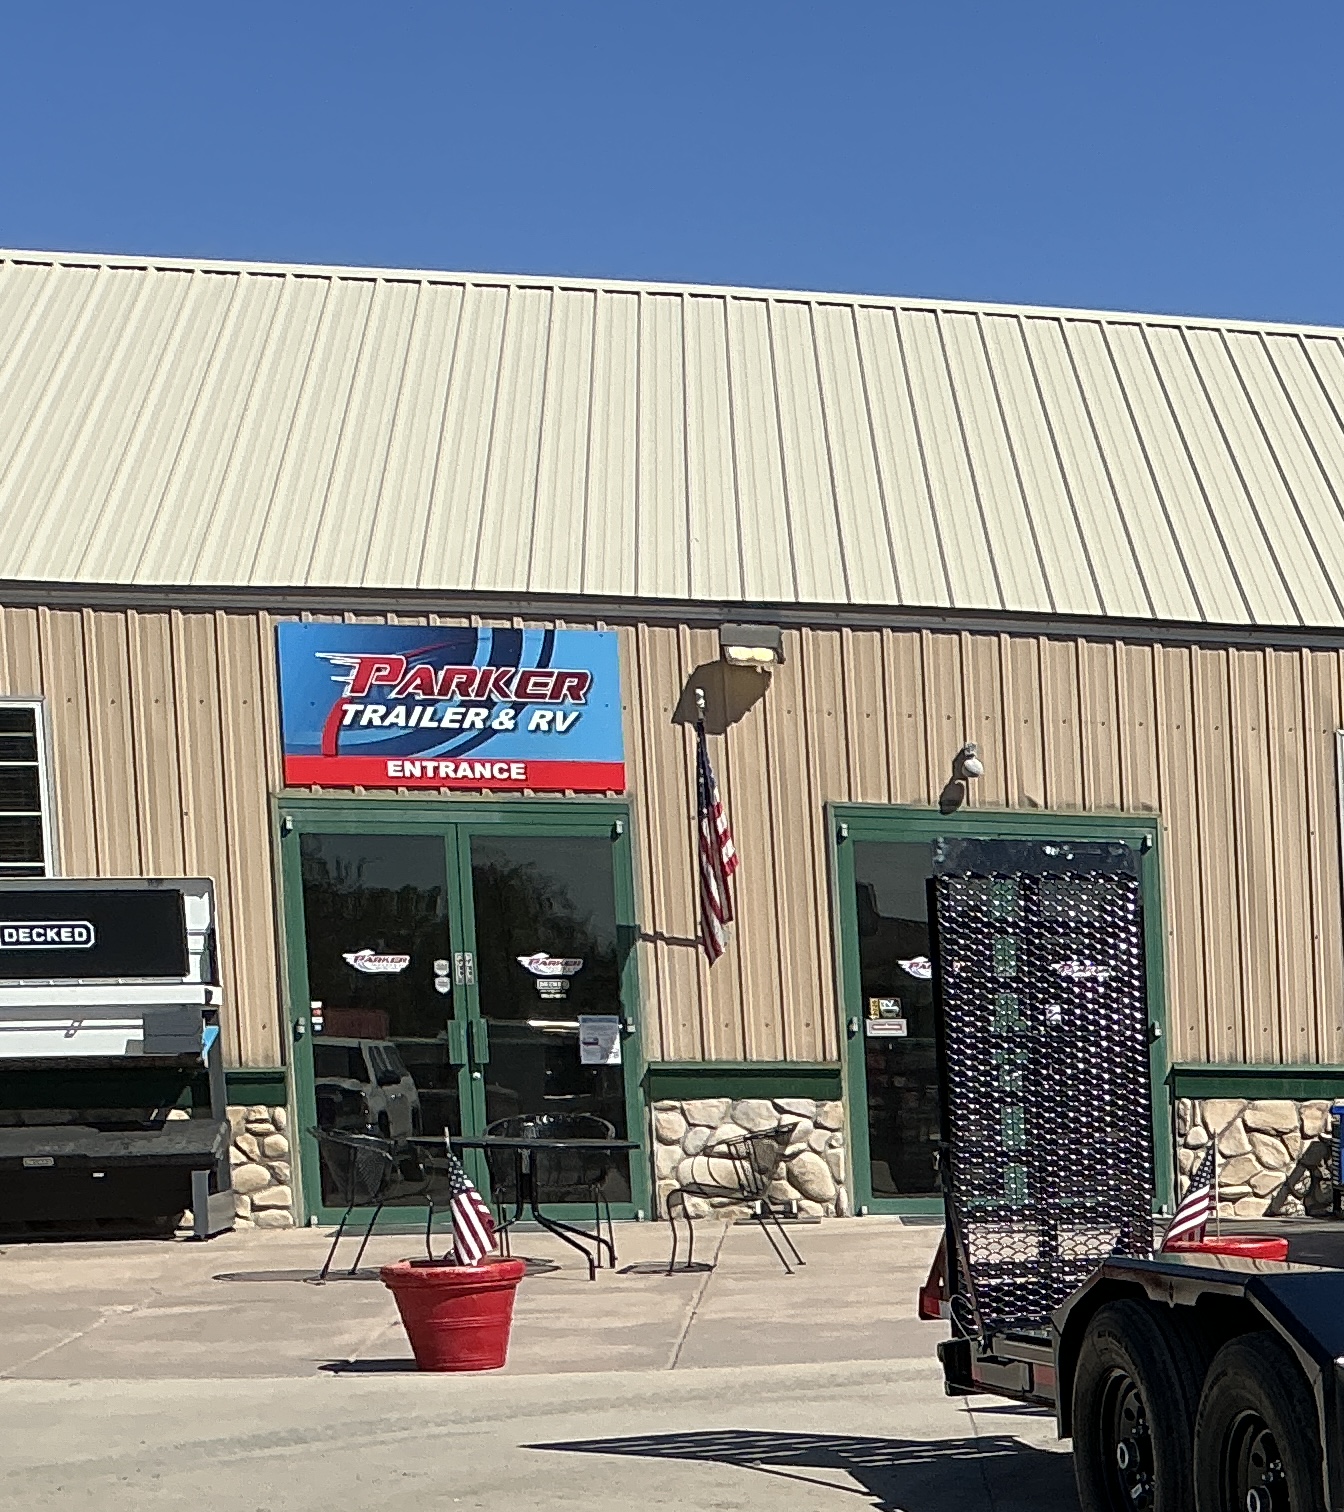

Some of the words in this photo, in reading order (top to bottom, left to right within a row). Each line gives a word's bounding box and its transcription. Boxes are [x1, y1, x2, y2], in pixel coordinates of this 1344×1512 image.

[343, 653, 593, 704] PARKER
[341, 703, 492, 730] TRAILER
[492, 707, 516, 730] &
[528, 709, 580, 733] RV
[387, 759, 526, 780] ENTRANCE
[3, 927, 88, 942] DECKED
